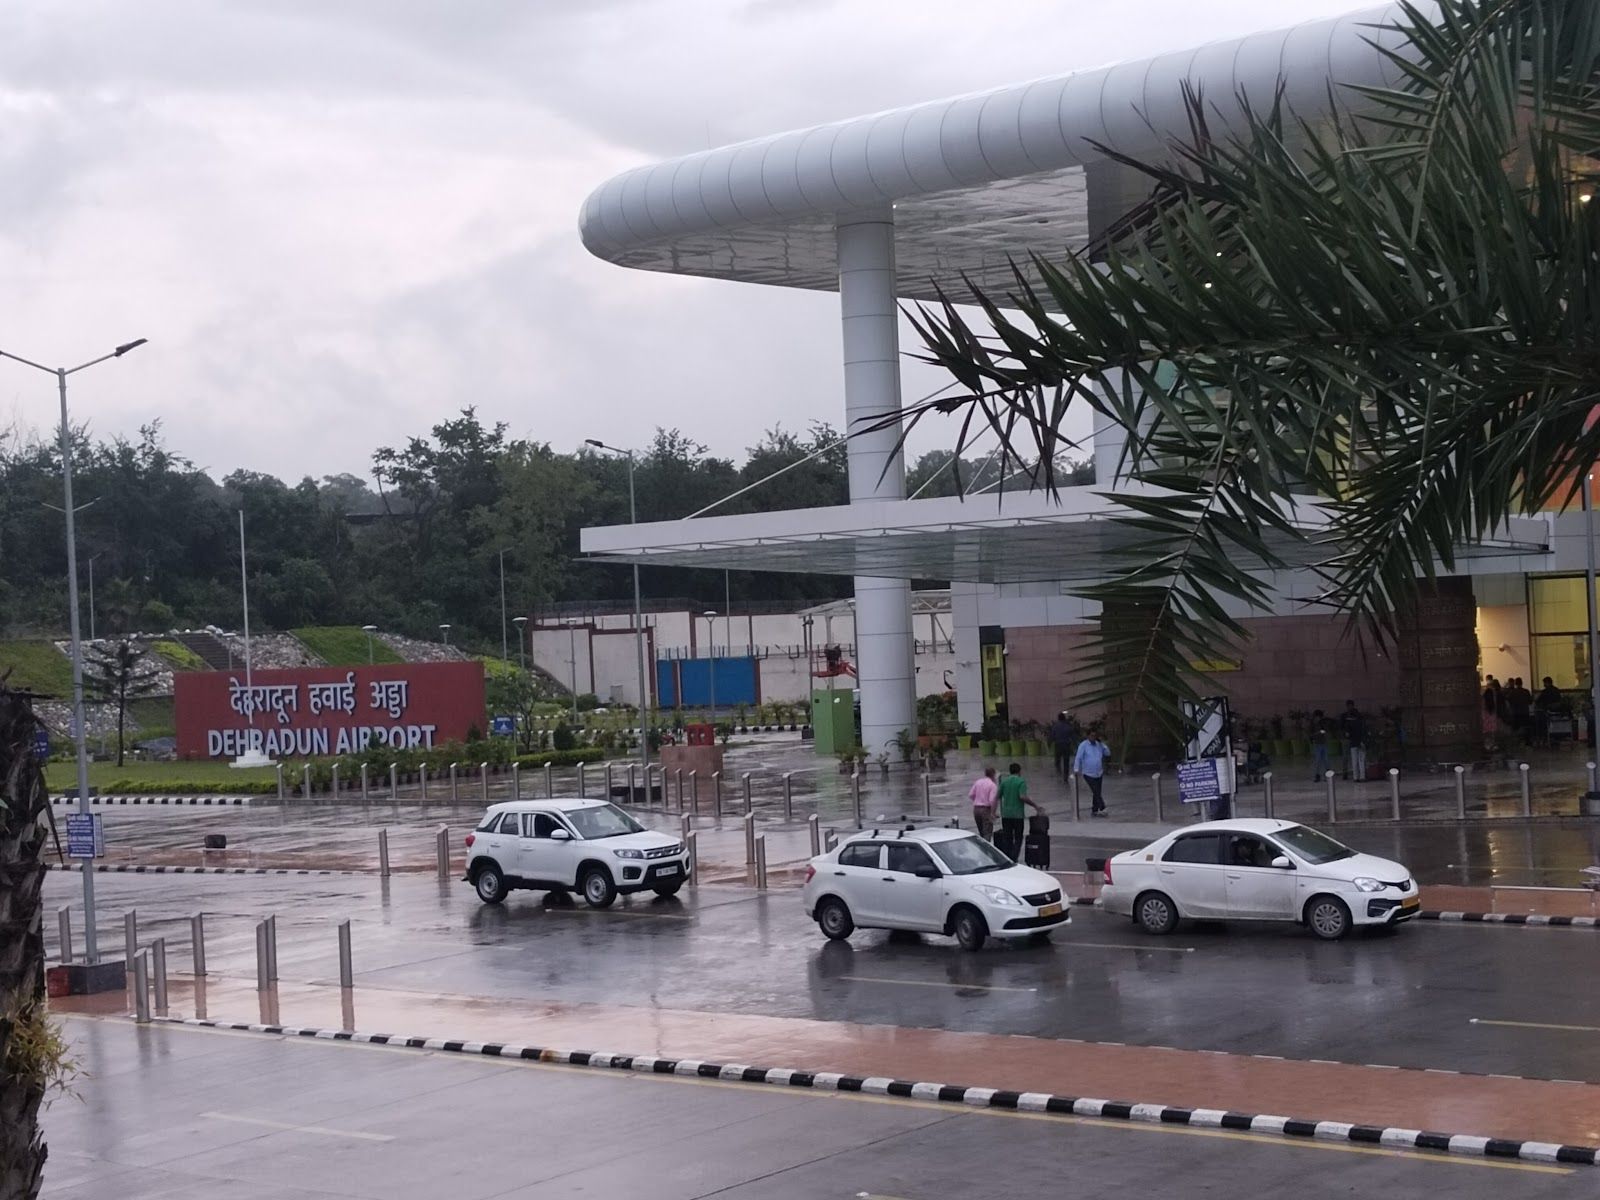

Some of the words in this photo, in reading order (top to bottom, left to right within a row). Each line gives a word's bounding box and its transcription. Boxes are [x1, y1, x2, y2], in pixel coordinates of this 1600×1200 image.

[229, 676, 298, 723] देहरादून
[308, 671, 355, 715] हवाई
[370, 680, 408, 719] अड्डा
[208, 727, 329, 756] DEHRADUN
[335, 724, 436, 754] AIRPORT
